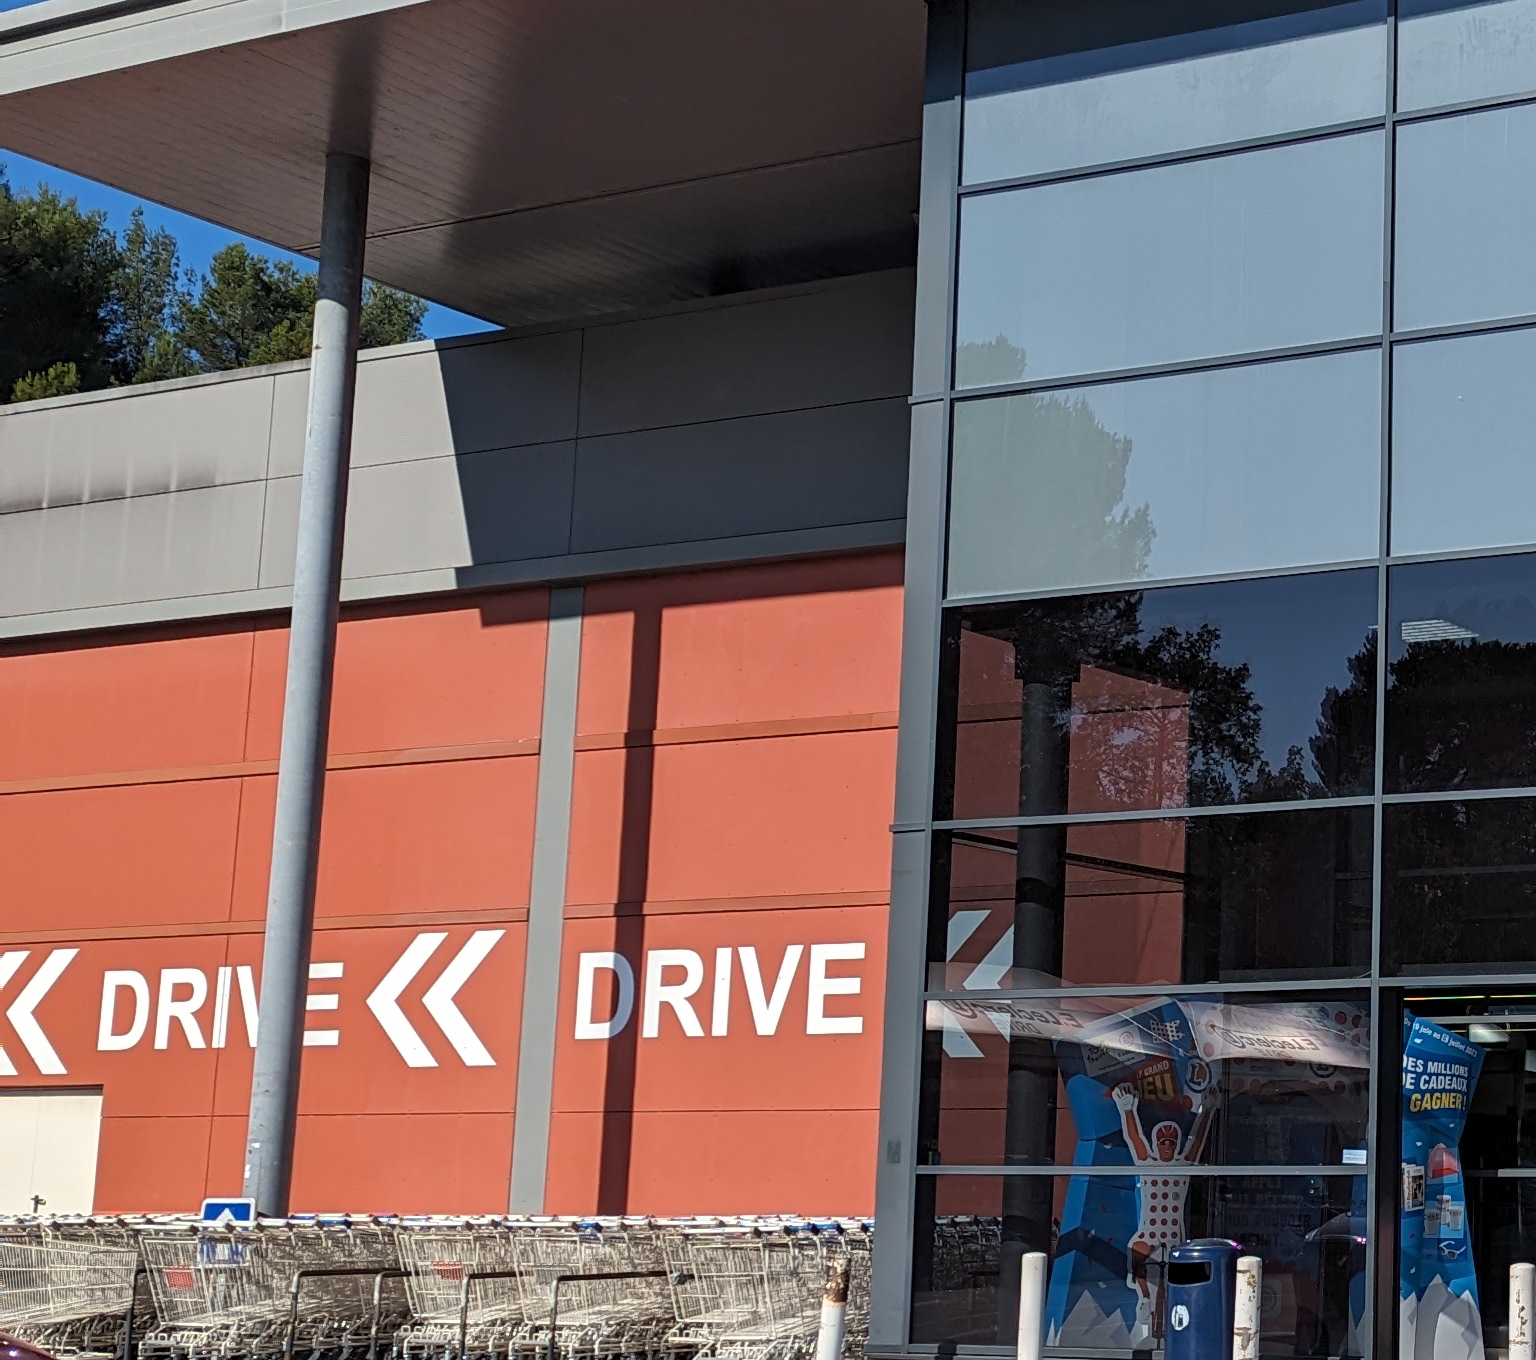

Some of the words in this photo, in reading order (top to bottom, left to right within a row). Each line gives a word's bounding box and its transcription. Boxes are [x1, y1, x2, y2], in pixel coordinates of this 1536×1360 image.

[574, 942, 865, 1040] DRIVE
[1144, 1060, 1169, 1077] GRAND
[1427, 1061, 1468, 1078] MILLIONS
[1402, 1072, 1416, 1089] E
[1420, 1074, 1468, 1093] CADEAUX
